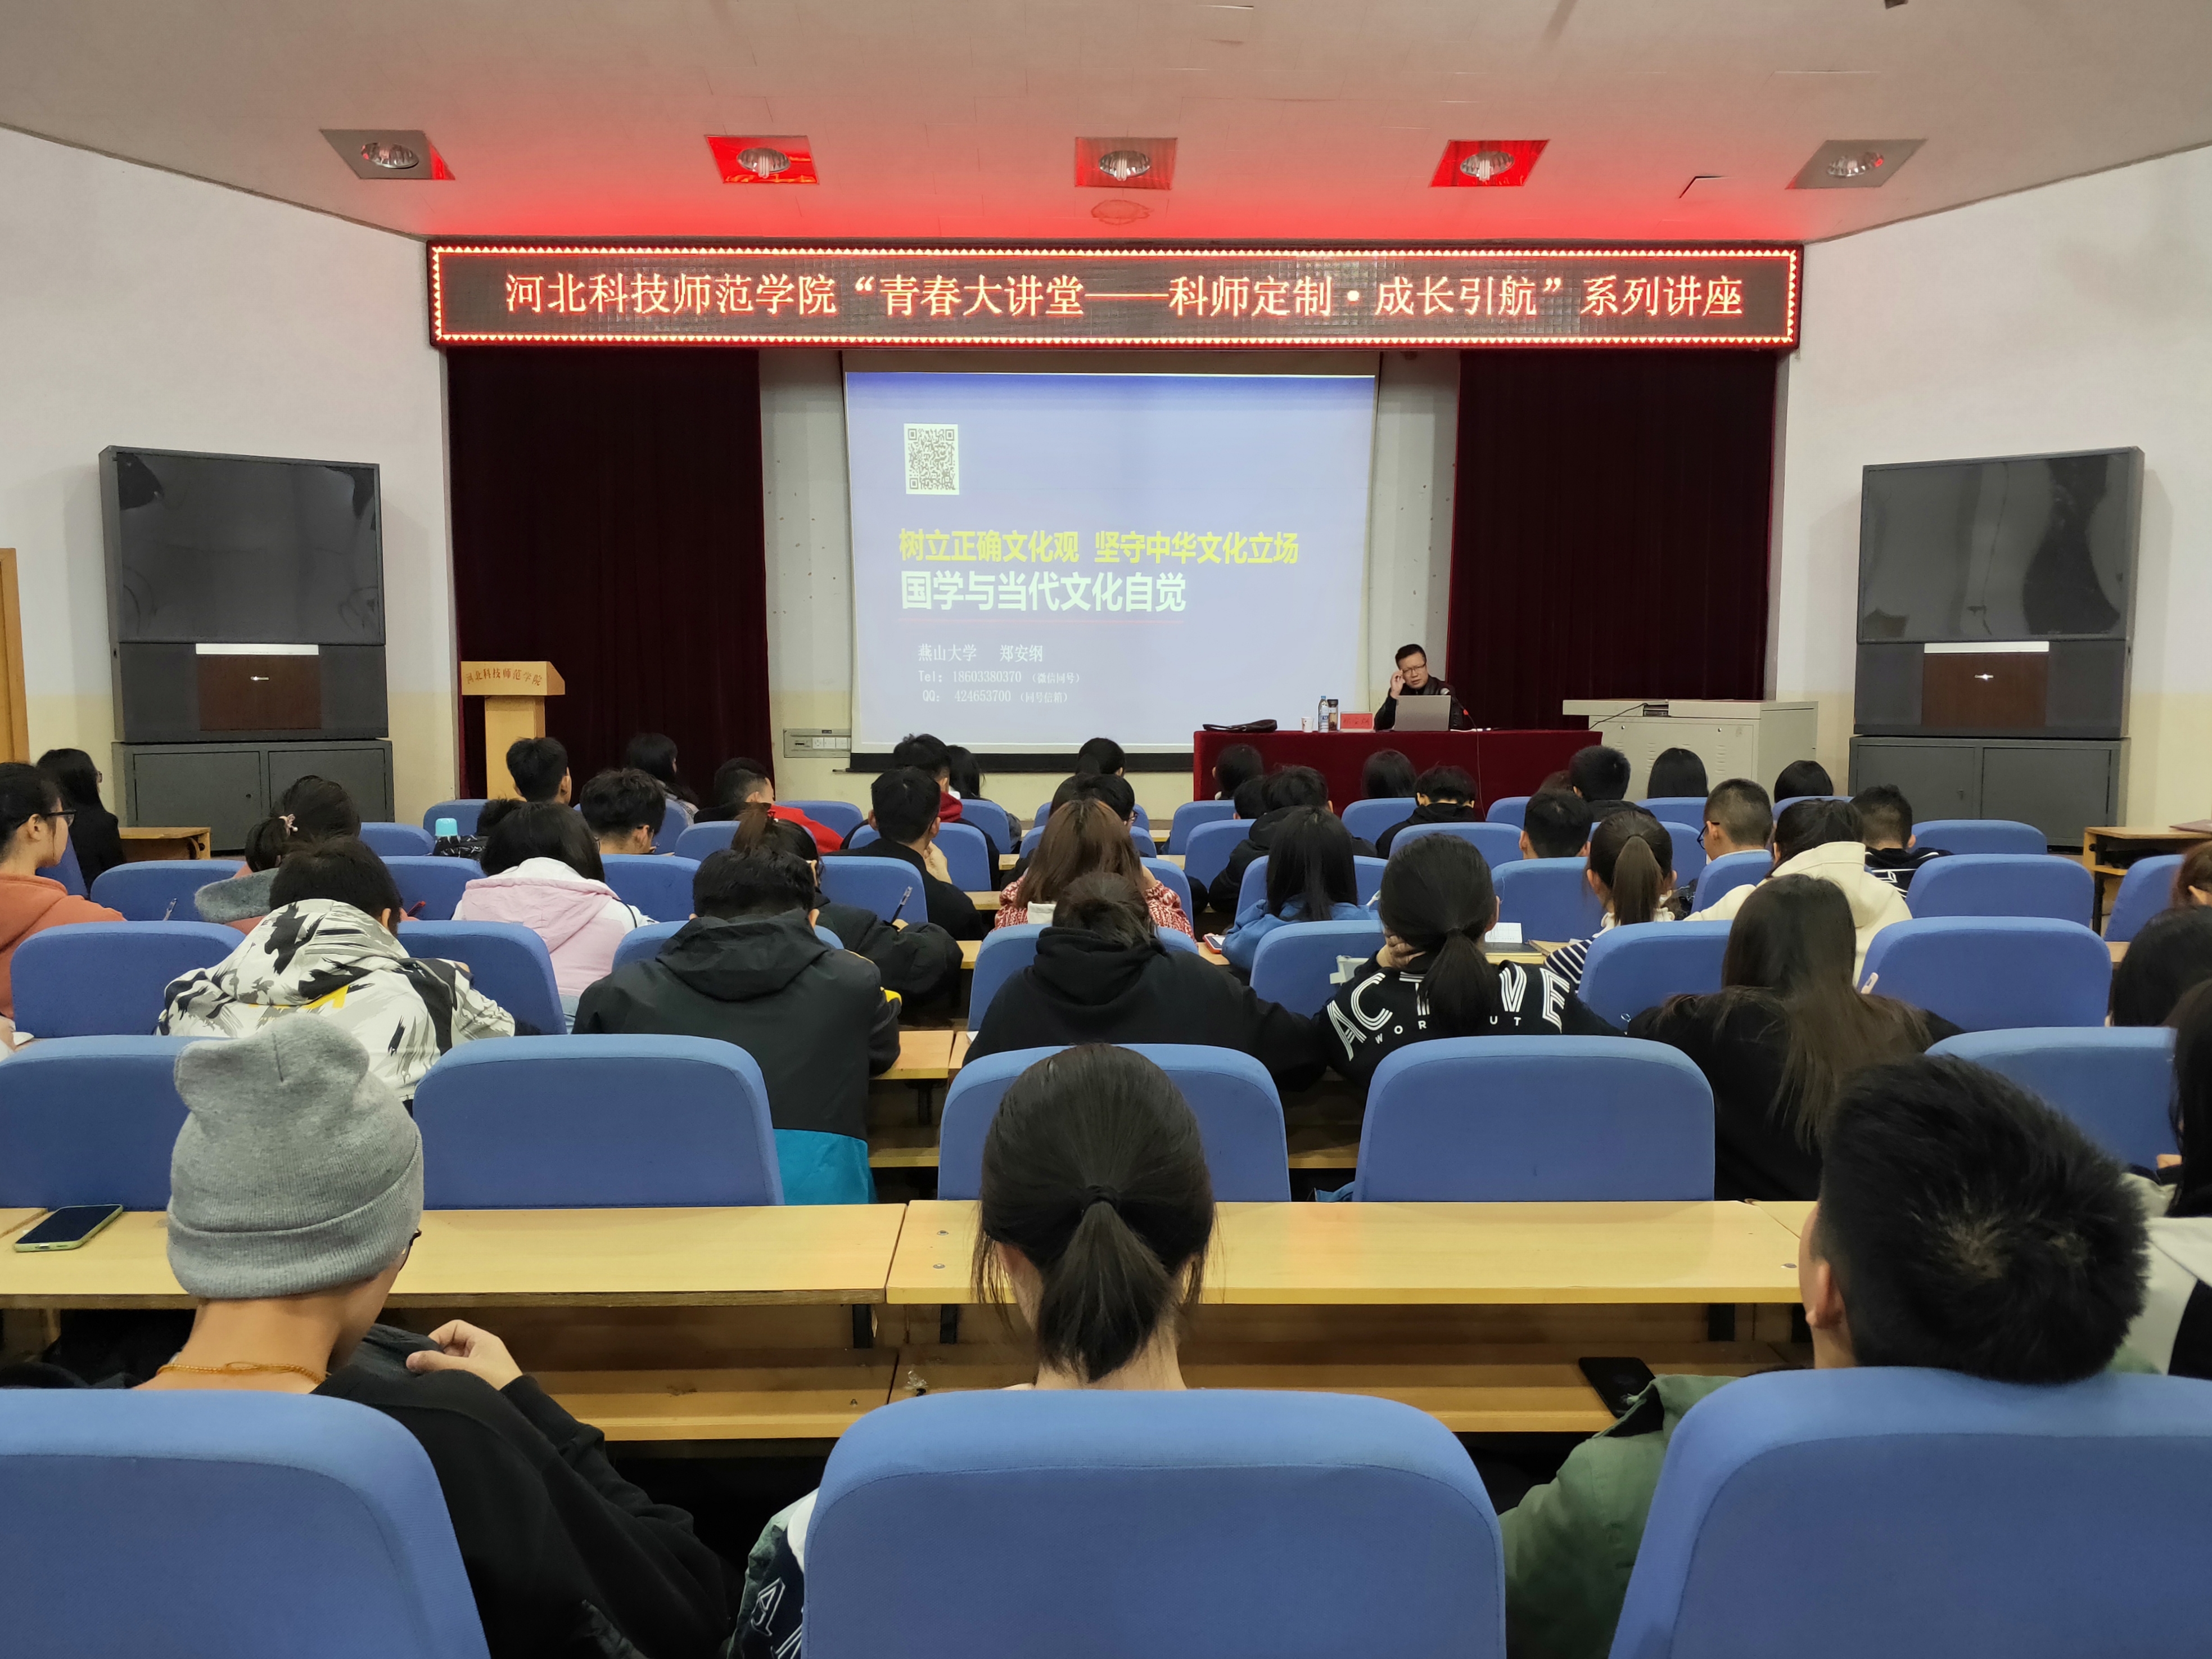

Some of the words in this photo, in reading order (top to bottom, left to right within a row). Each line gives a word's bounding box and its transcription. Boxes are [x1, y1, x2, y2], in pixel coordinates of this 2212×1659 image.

[899, 528, 1080, 563] 树立正确文化观
[1094, 530, 1299, 565] 坚守中华文化立场
[900, 570, 1187, 612] 国学与当代文化自觉
[918, 643, 977, 662] 燕山大学
[999, 643, 1044, 662] 郑安纲
[466, 668, 542, 686] 河北科技师范学院
[1326, 964, 1570, 1061] ACTVE
[1375, 1015, 1522, 1044] WORUT
